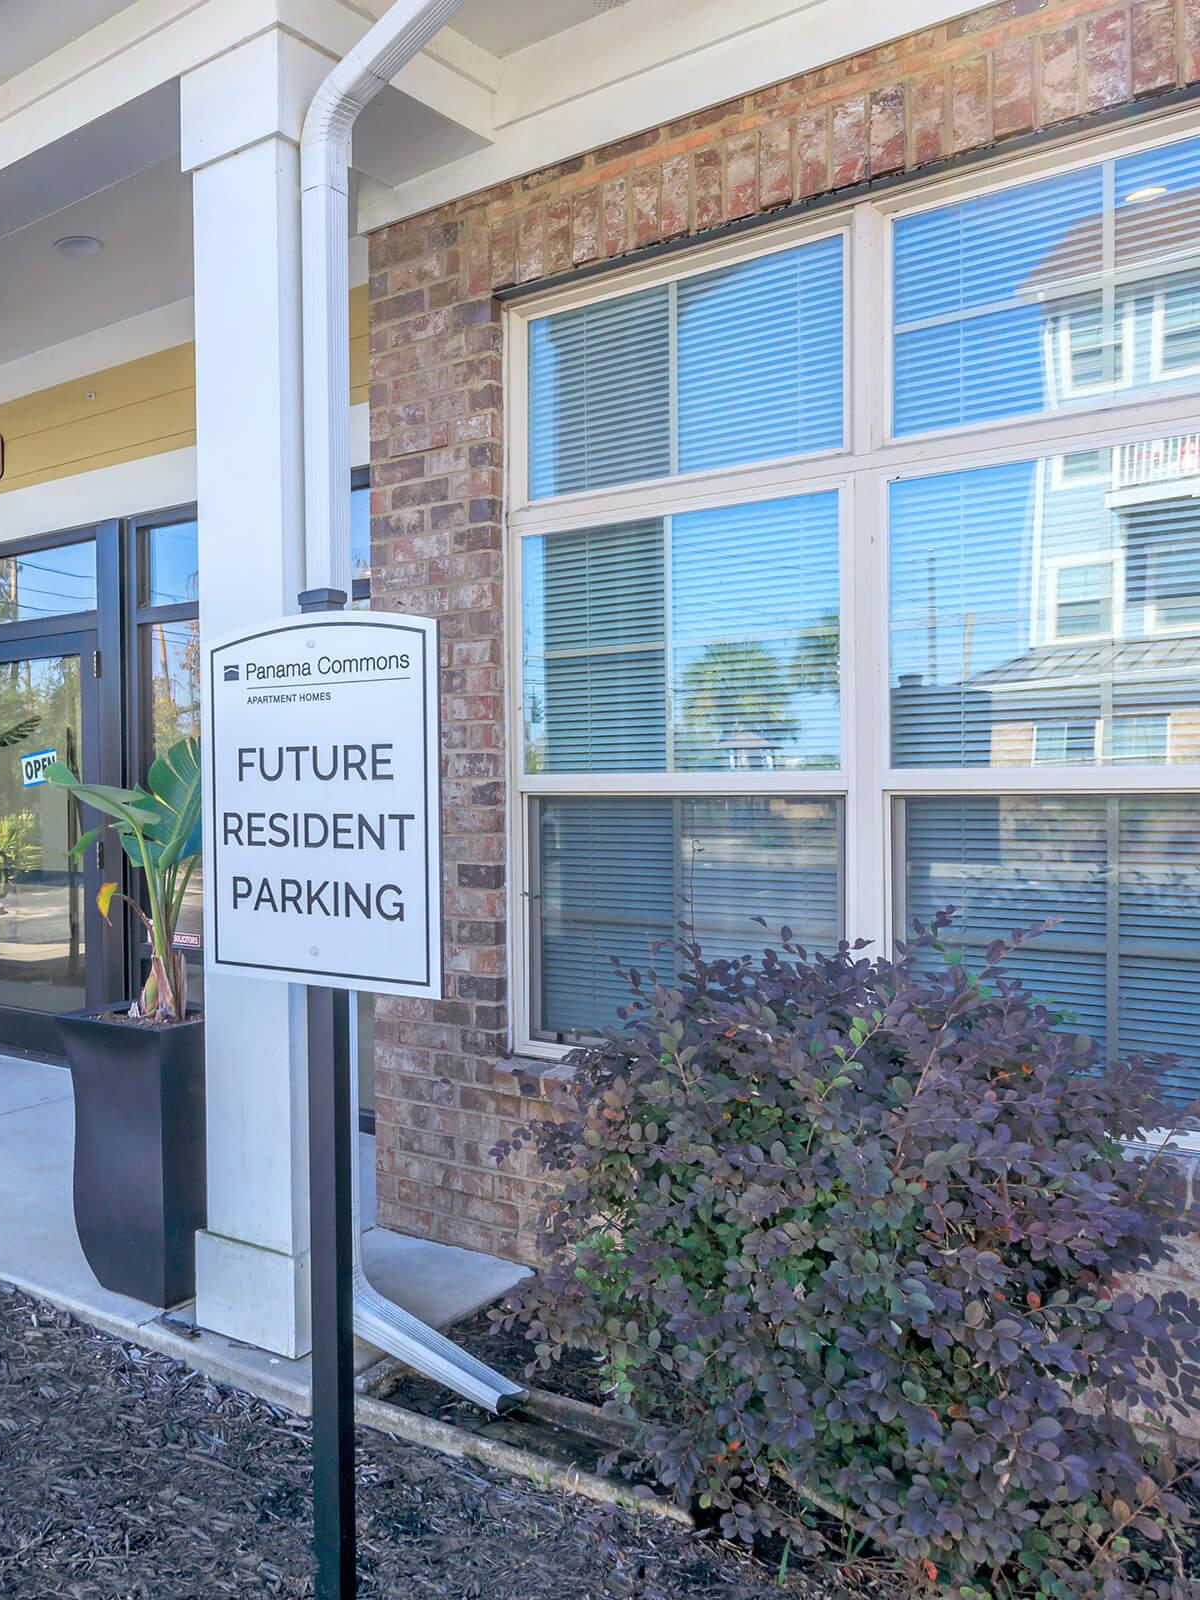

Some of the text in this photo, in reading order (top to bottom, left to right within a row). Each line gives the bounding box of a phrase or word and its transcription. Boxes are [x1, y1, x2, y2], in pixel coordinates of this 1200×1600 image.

[245, 653, 411, 681] Panama Commons
[246, 692, 332, 705] APARTMENT HOMES
[237, 743, 395, 782] FUTURE
[223, 812, 416, 852] RESIDENT
[232, 875, 406, 922] PARKING
